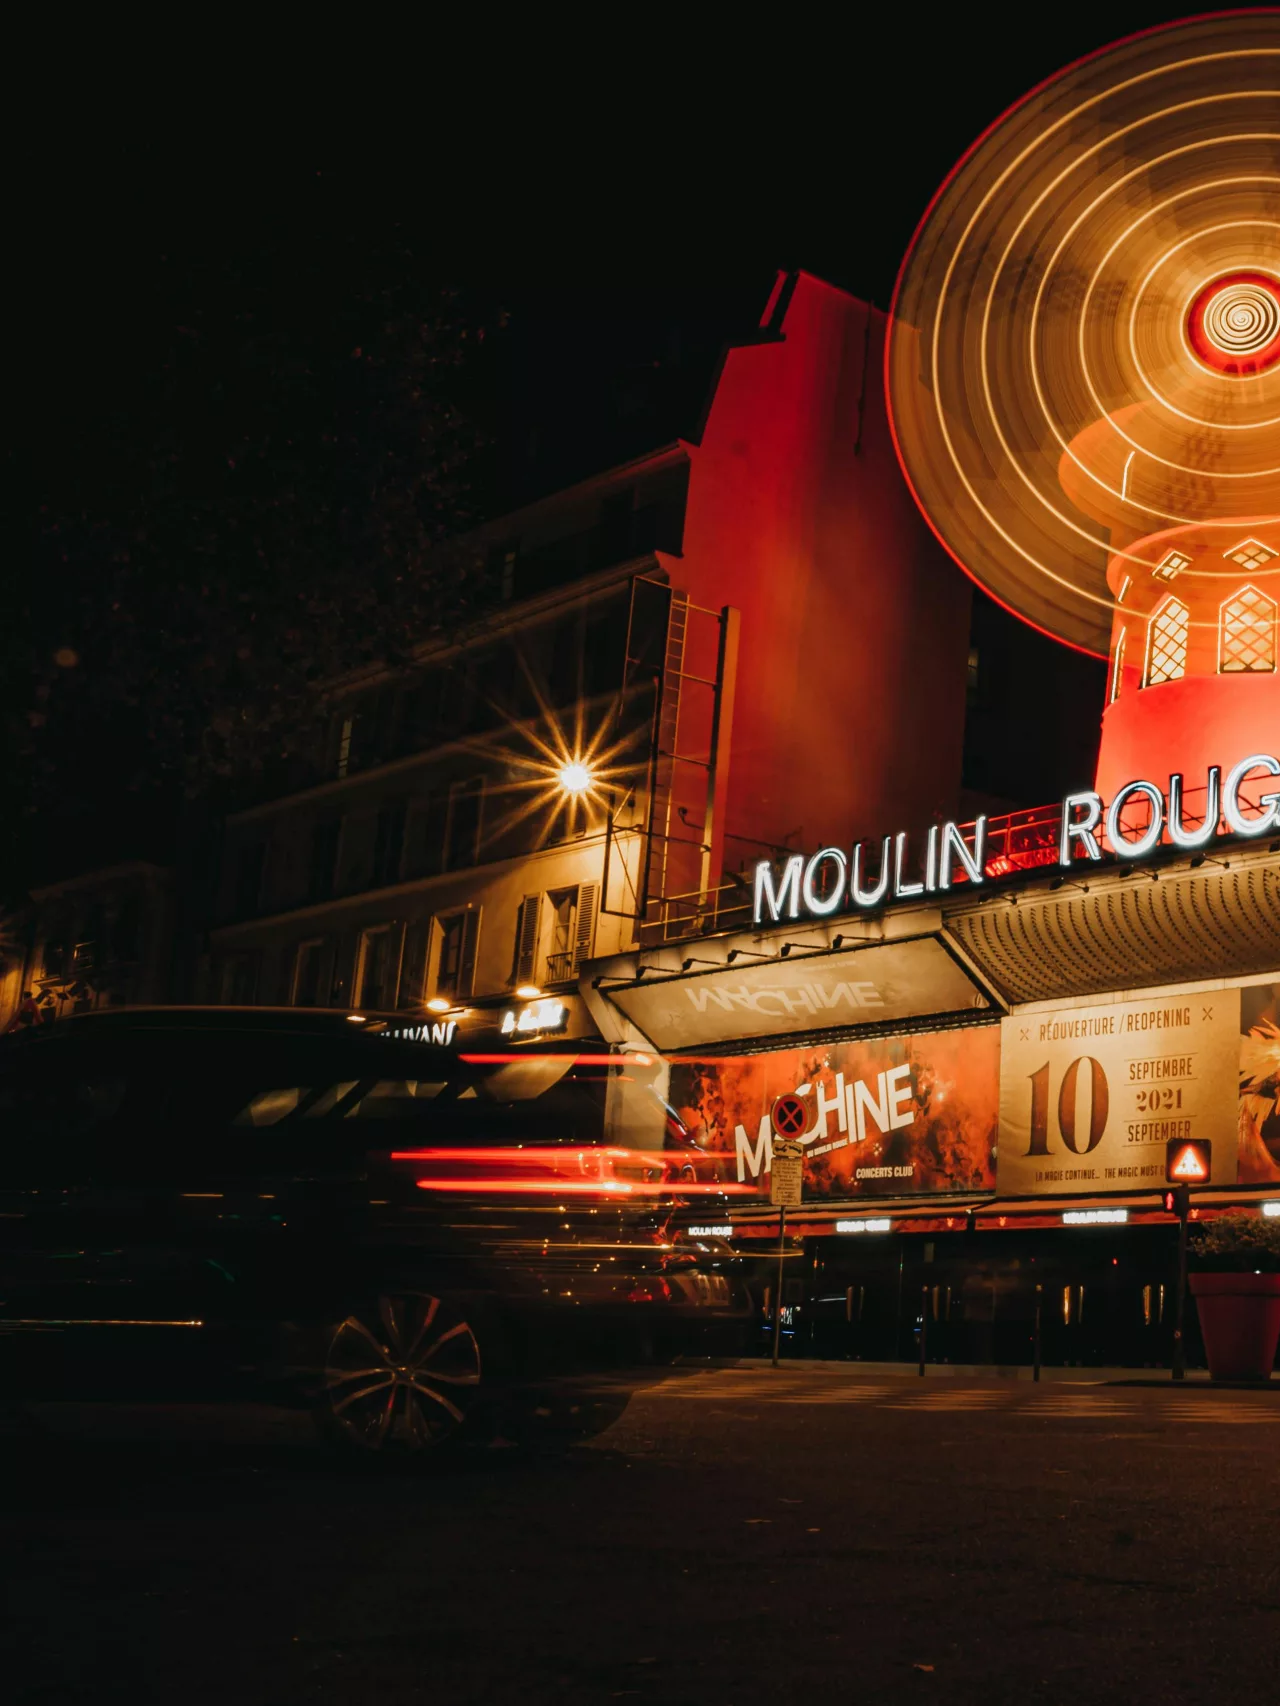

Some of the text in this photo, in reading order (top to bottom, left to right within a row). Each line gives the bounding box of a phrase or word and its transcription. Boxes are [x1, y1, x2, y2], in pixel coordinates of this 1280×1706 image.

[753, 814, 986, 923] MOULIN
[1127, 1007, 1191, 1032] REOPENING
[1129, 1057, 1193, 1081] SEPTEMBRE
[1021, 1055, 1110, 1157] 10
[1135, 1087, 1183, 1112] 2021
[734, 1063, 915, 1183] MCHINE
[1128, 1120, 1192, 1143] SEPTEMBER
[856, 1165, 914, 1179] CONCERTS CLUB
[1104, 1167, 1116, 1179] THE
[1118, 1166, 1139, 1178] MAGIC
[1140, 1165, 1158, 1177] MUST
